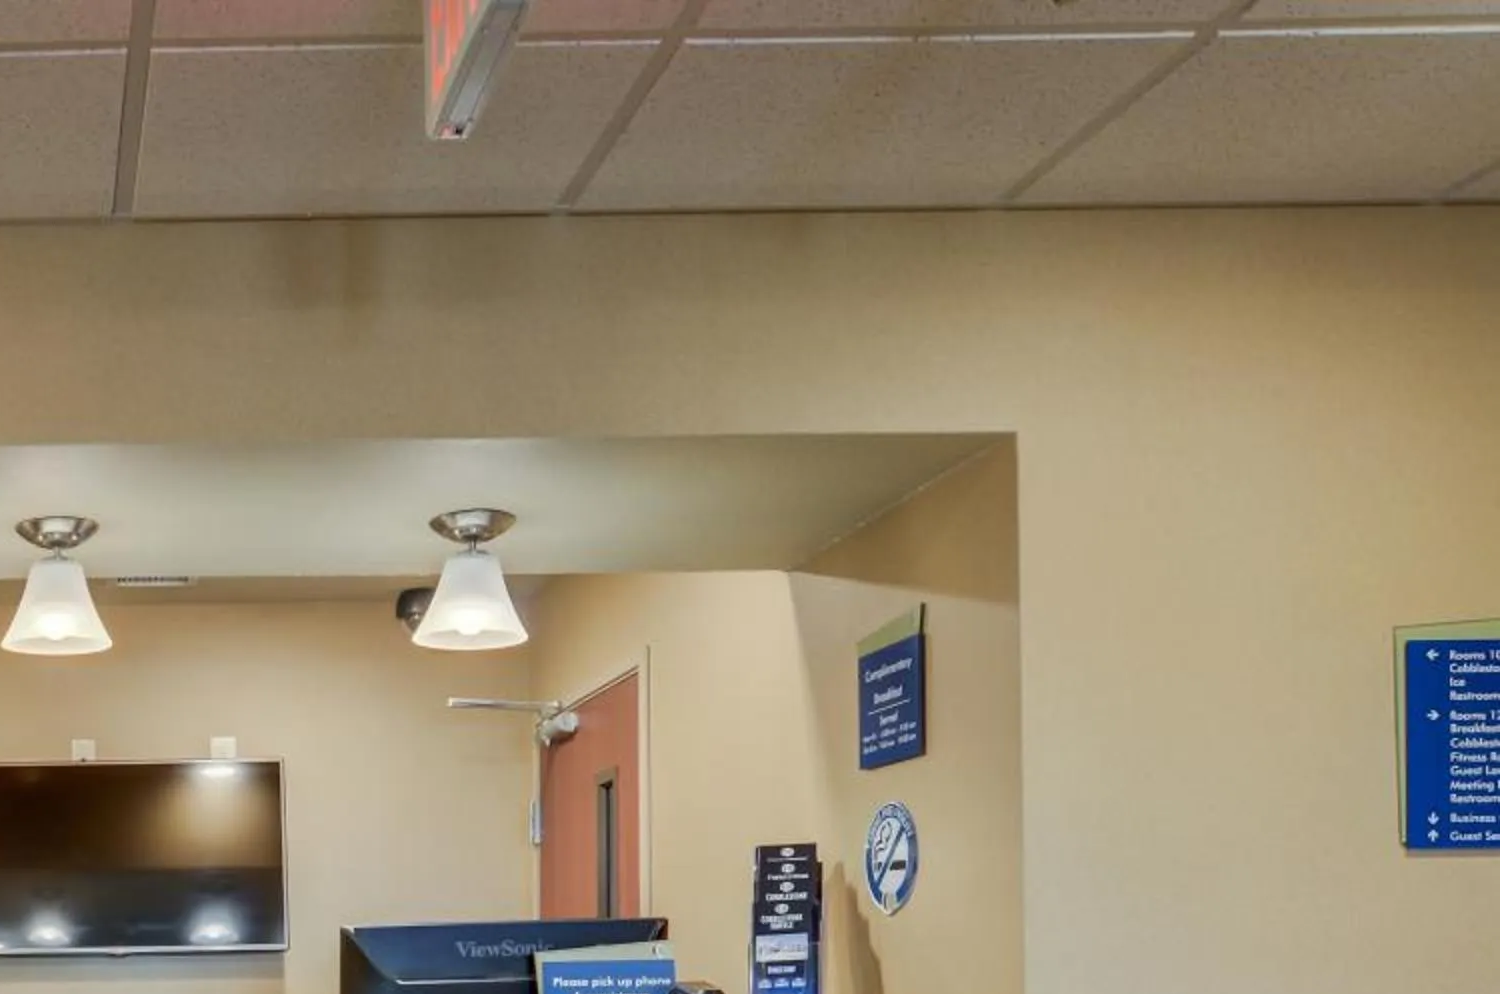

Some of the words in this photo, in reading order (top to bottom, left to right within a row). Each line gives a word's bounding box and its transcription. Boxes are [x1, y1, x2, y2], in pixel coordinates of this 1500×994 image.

[1449, 649, 1486, 660] Rooms
[1449, 676, 1466, 687] Ice
[1449, 710, 1487, 721] Rooms
[1449, 765, 1483, 777] Guest
[1449, 779, 1495, 793] Meeting
[1449, 830, 1483, 841] Guest
[552, 976, 589, 988] Please
[590, 976, 615, 991] pick
[617, 979, 633, 990] up
[635, 976, 672, 988] phone
